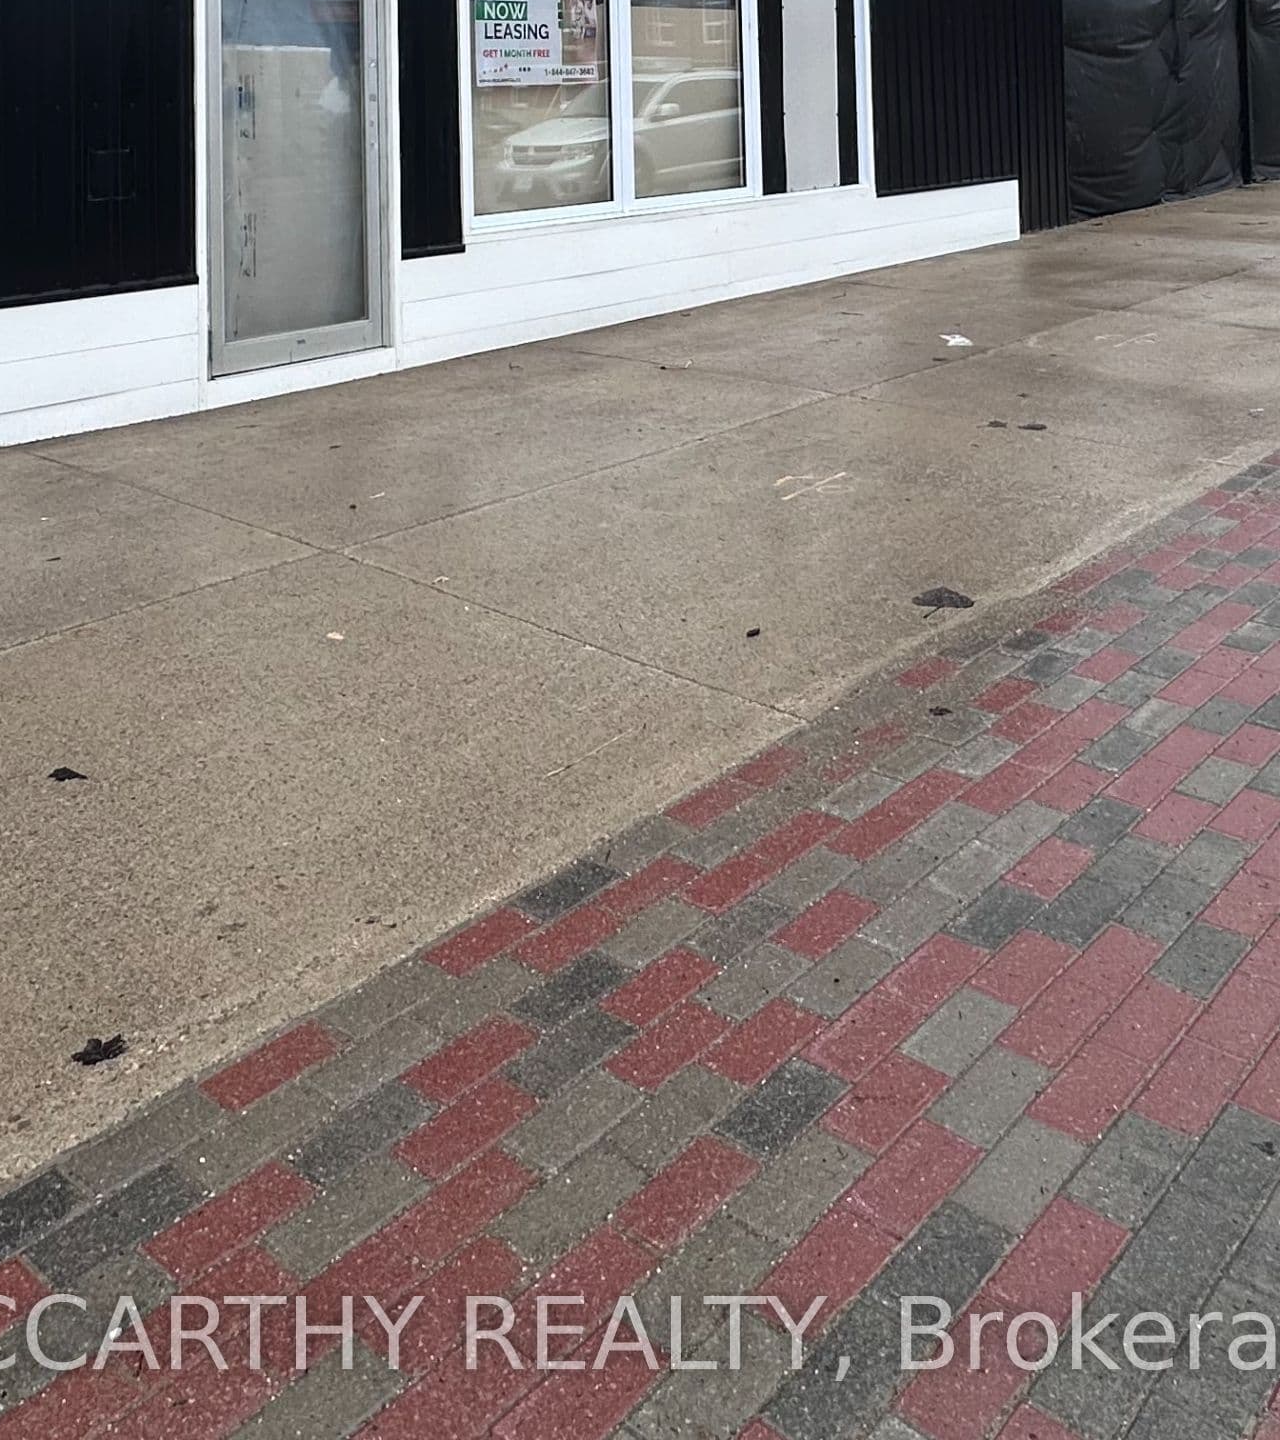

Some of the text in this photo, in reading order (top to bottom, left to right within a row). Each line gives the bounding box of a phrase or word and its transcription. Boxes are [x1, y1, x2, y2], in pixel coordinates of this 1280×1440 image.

[483, 2, 526, 20] NOW
[484, 23, 549, 40] LEASING
[483, 49, 497, 58] GET
[504, 49, 532, 58] MONTH
[533, 49, 550, 58] FREE
